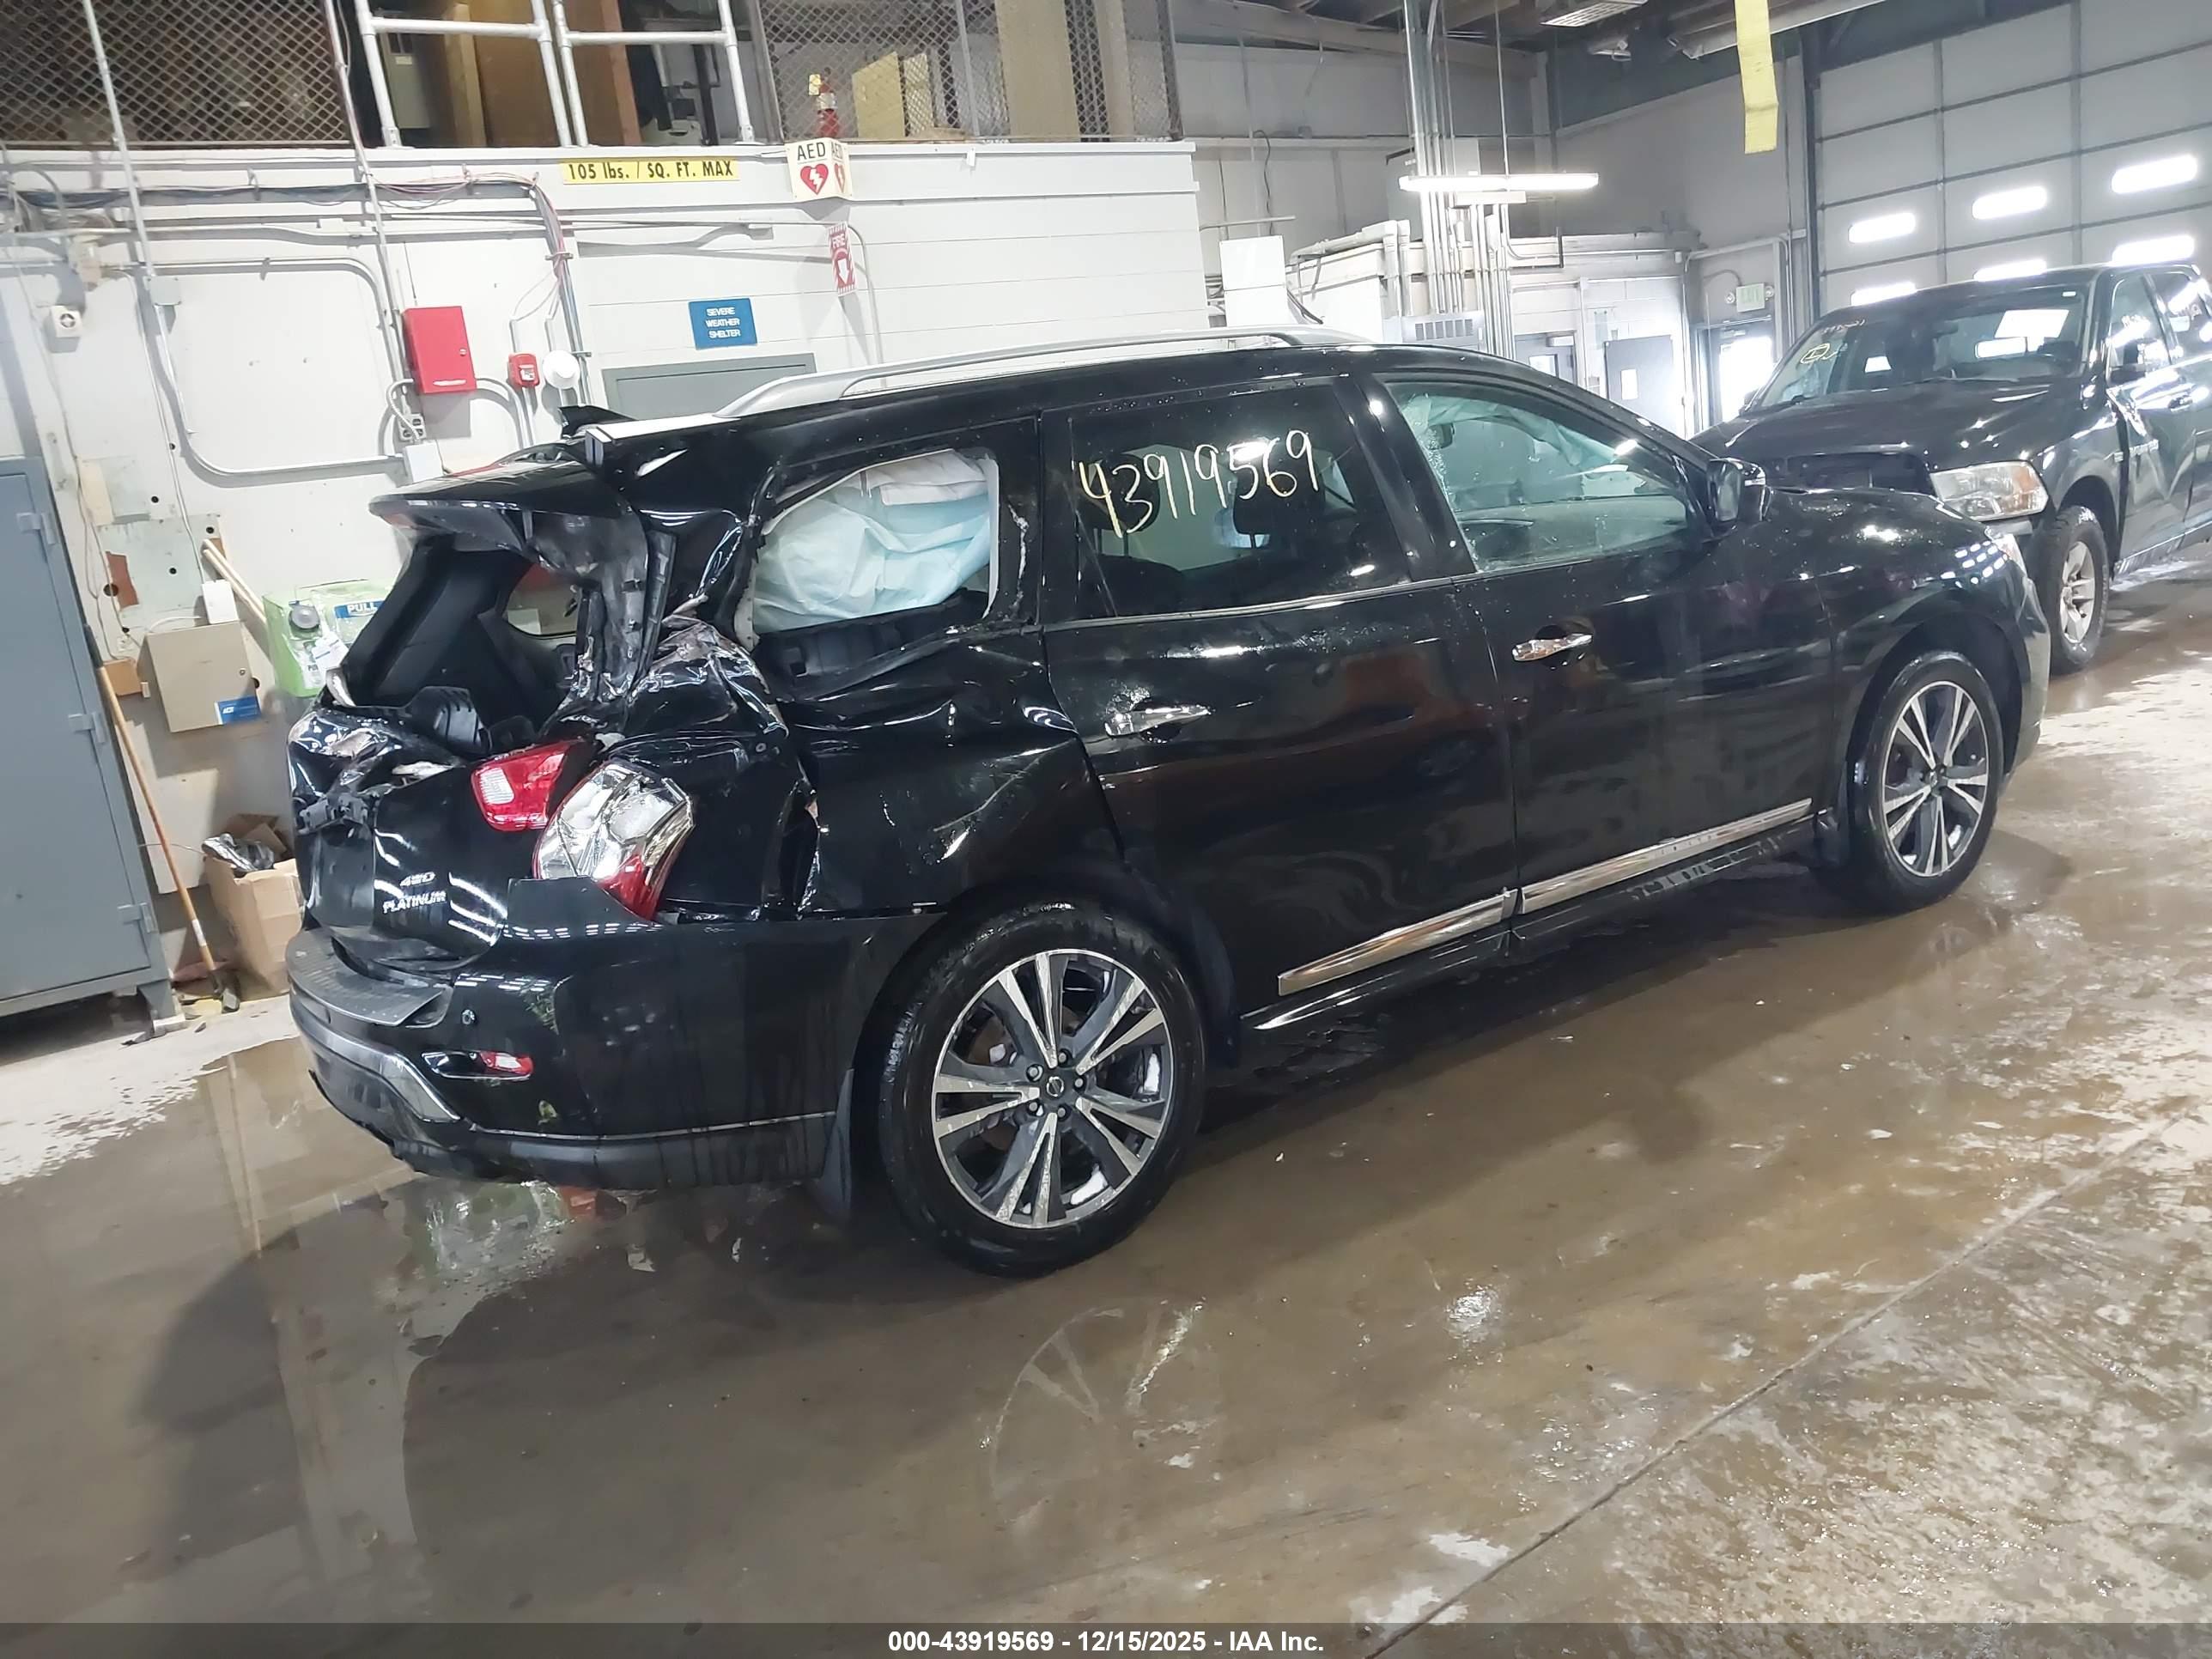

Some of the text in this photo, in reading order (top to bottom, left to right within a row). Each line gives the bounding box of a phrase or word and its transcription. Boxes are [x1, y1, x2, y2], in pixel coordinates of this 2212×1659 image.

[797, 142, 826, 161] AED
[831, 141, 843, 160] AED
[568, 163, 597, 179] 105
[603, 161, 629, 179] lbs.
[647, 162, 671, 178] SQ.
[677, 161, 696, 177] FT.
[702, 161, 733, 177] MAX
[706, 307, 736, 317] SEVERE
[705, 318, 741, 328] WEATHER
[708, 329, 742, 338] SHELTER
[1079, 430, 1319, 538] 43919569
[346, 601, 378, 613] PULL
[399, 871, 435, 887] 4WD
[383, 890, 447, 914] PLATINUM
